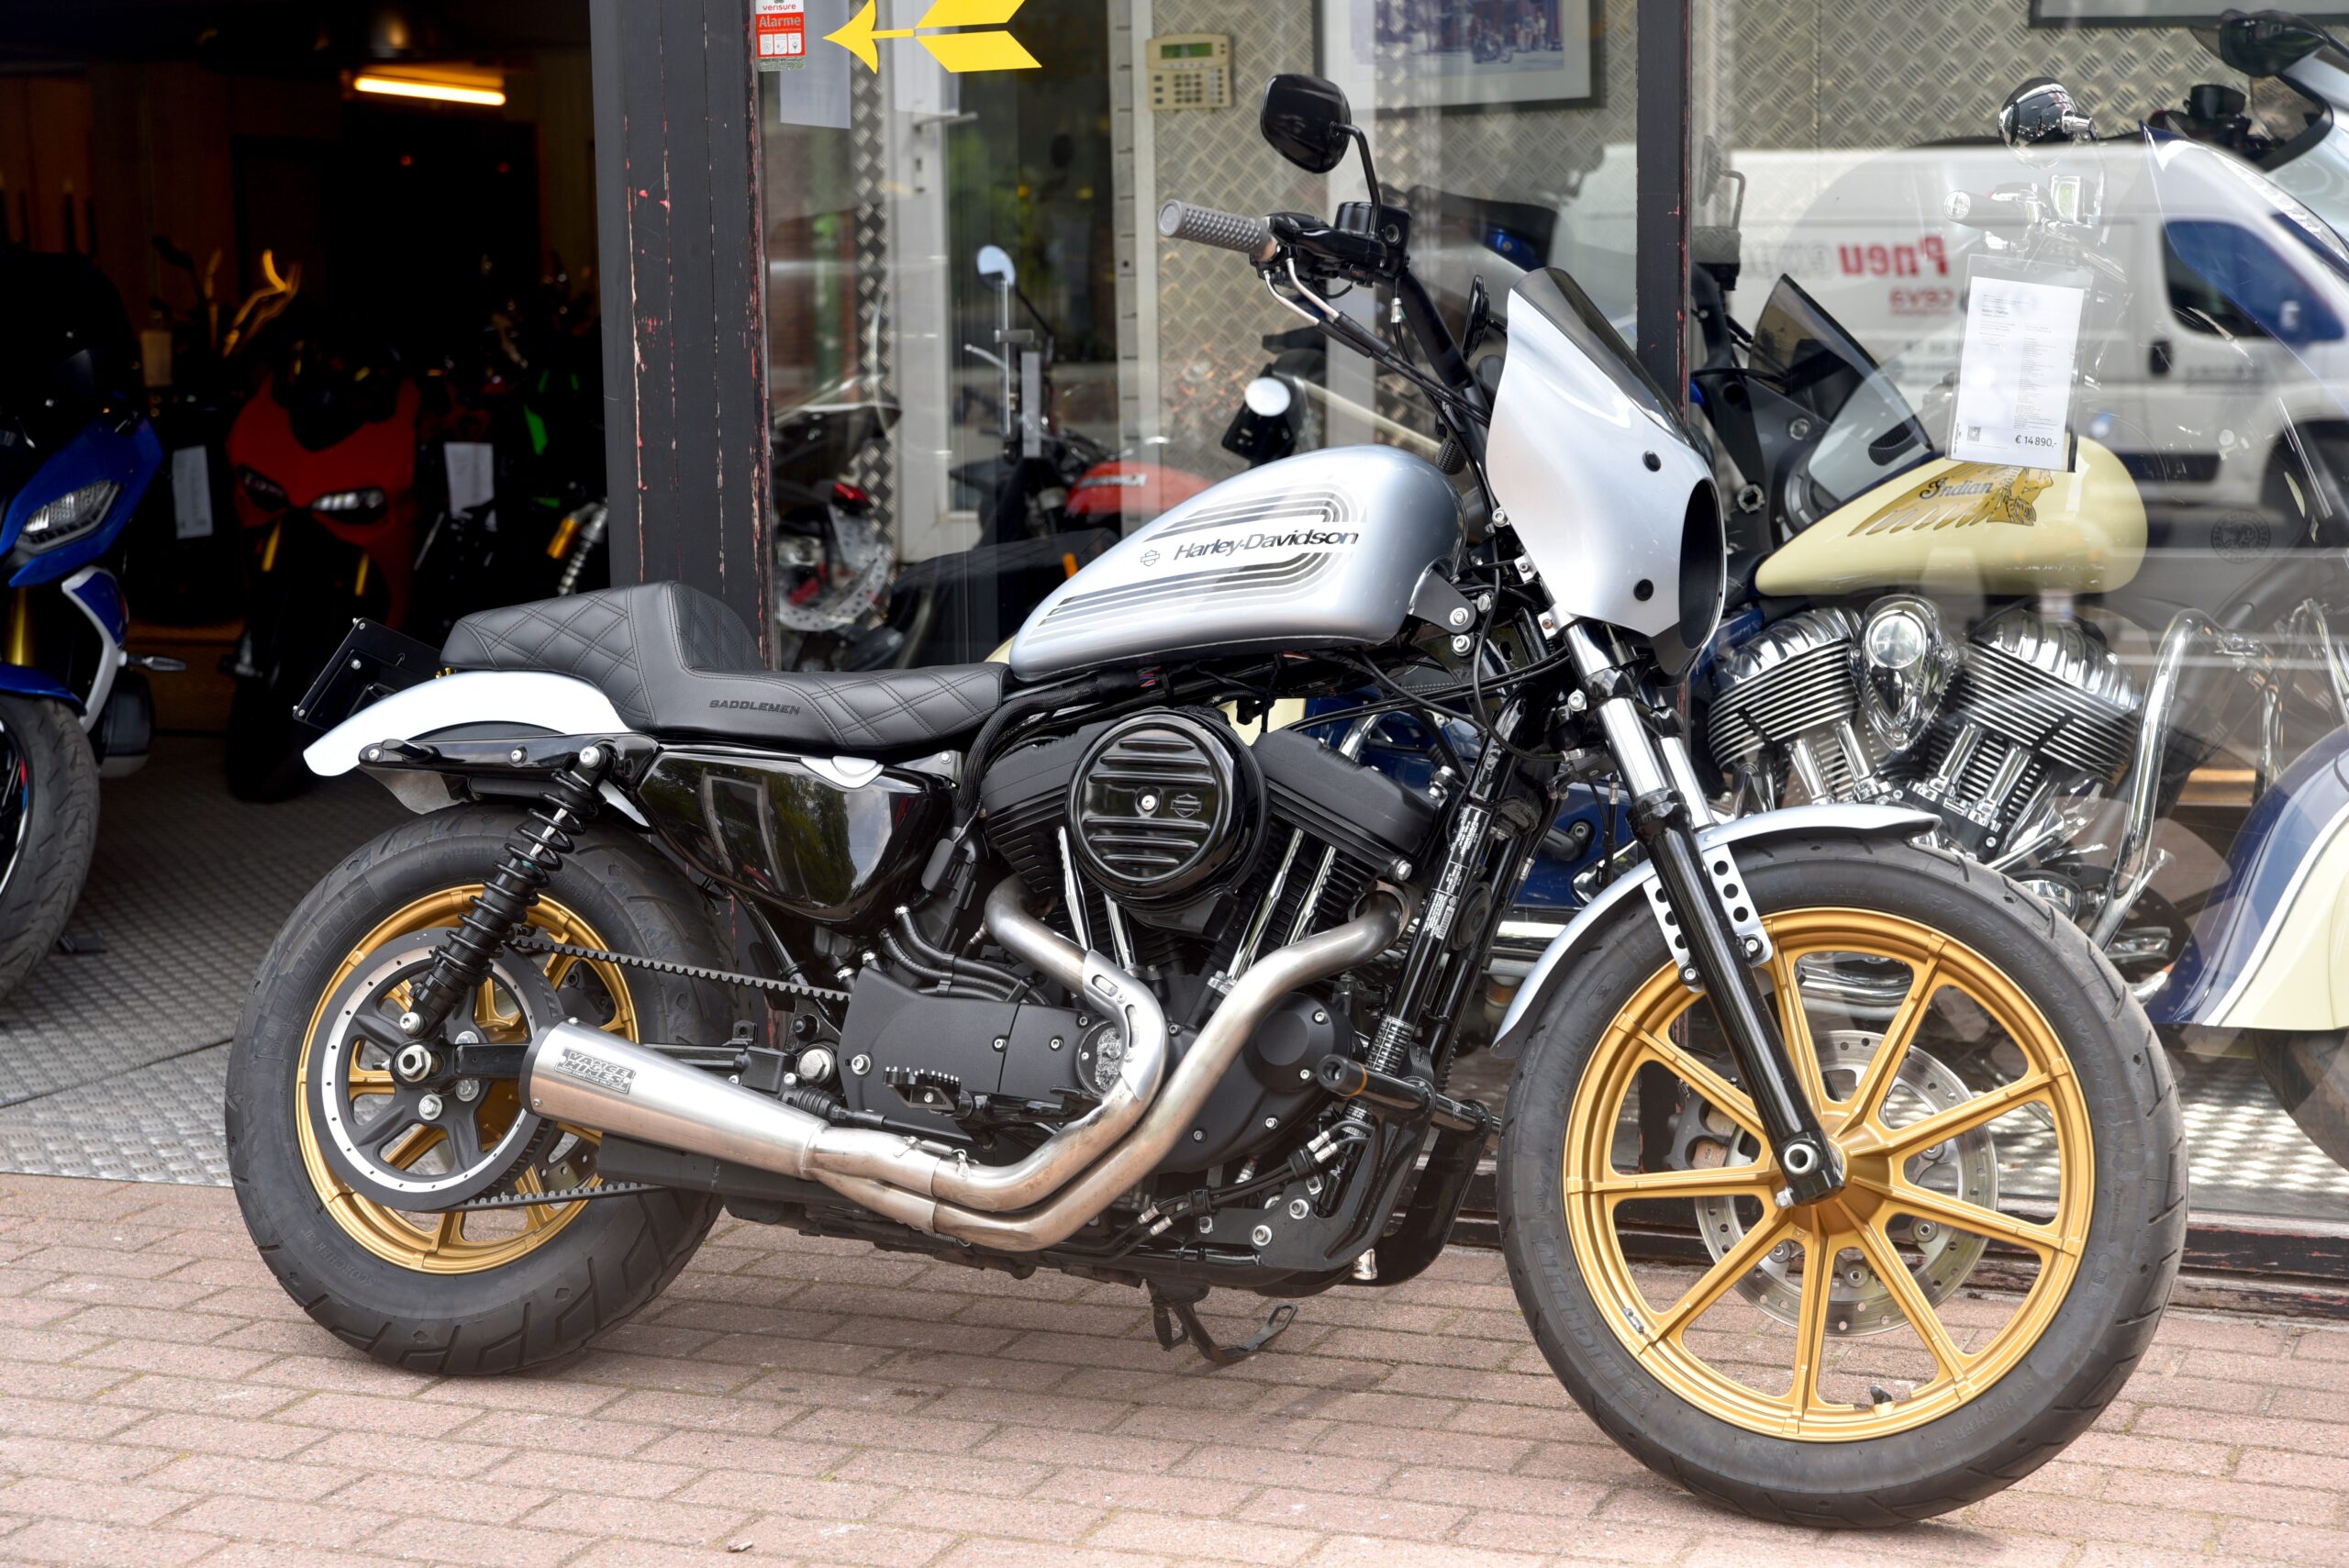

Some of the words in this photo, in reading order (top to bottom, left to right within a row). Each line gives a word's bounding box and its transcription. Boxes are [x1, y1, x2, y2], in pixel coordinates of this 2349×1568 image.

[759, 15, 801, 28] Alarme
[1919, 477, 1994, 499] Indian
[1173, 529, 1359, 561] Harley-Davidson
[709, 700, 801, 716] SADDLEMEN
[562, 1060, 623, 1086] HINES
[569, 1051, 631, 1077] VANCE
[317, 1240, 376, 1287] SCORCHER
[1954, 1378, 2035, 1440] SCORCHER
